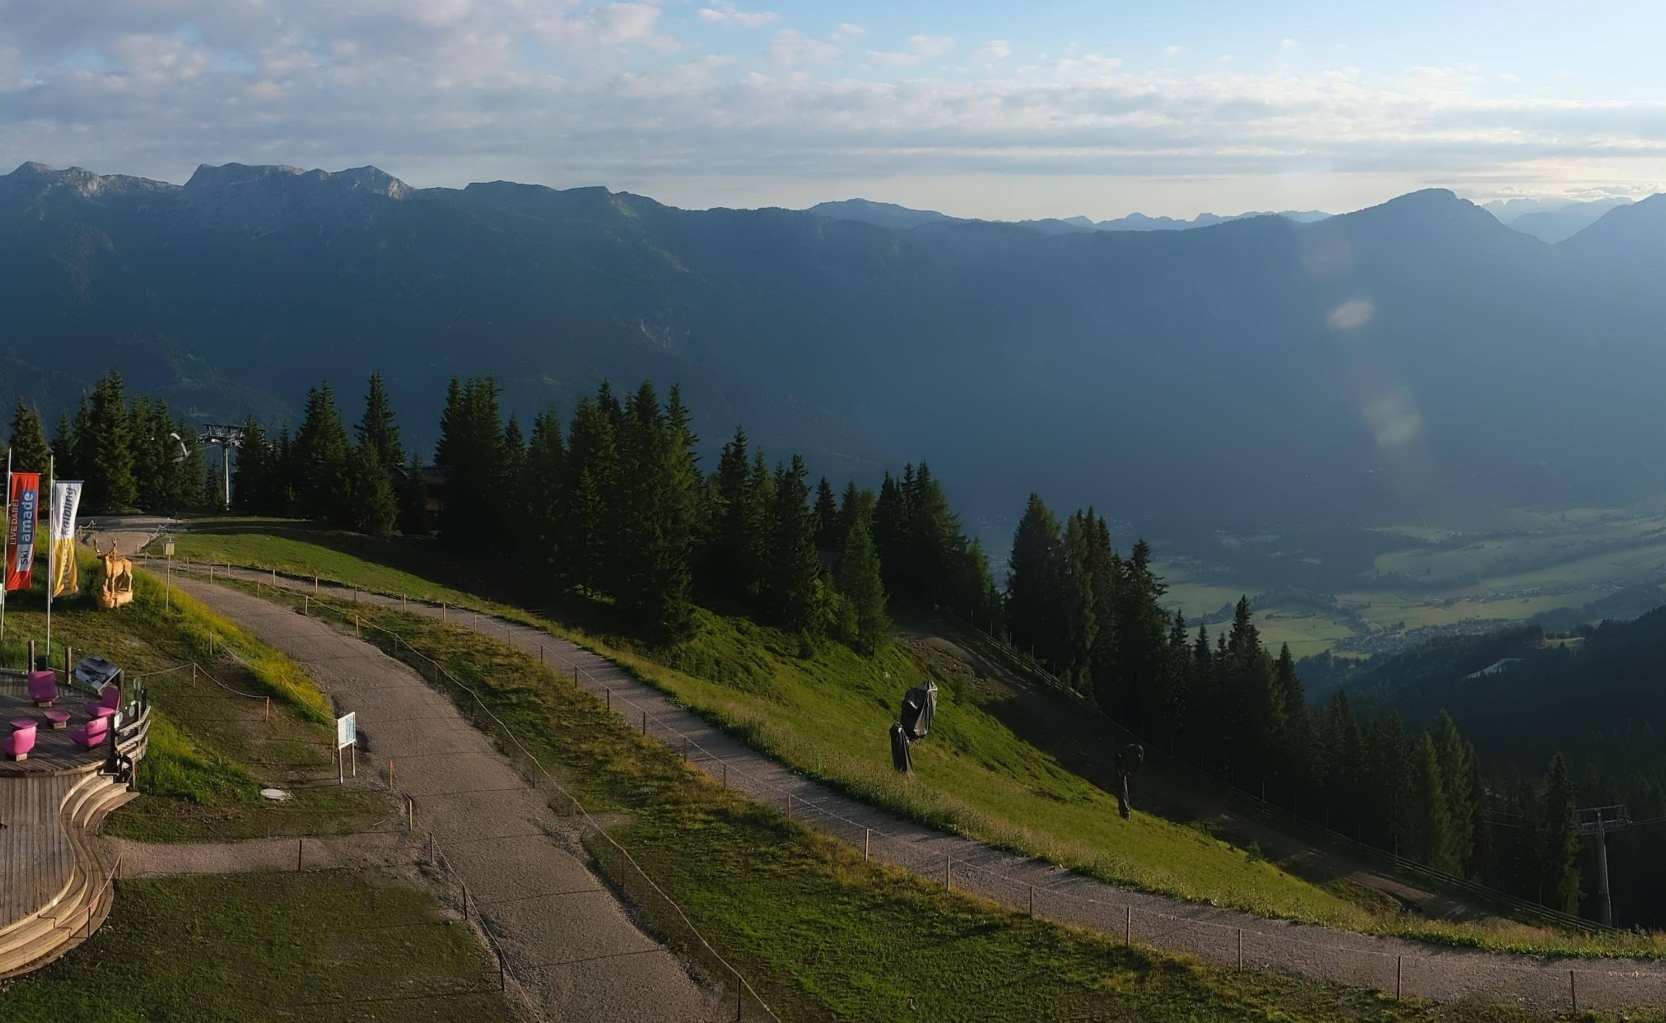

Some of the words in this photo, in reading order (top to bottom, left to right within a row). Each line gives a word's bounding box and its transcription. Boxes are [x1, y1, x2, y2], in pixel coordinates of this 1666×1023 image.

[11, 499, 20, 525] DABEI
[10, 526, 18, 545] LIVE
[20, 550, 29, 565] Ski
